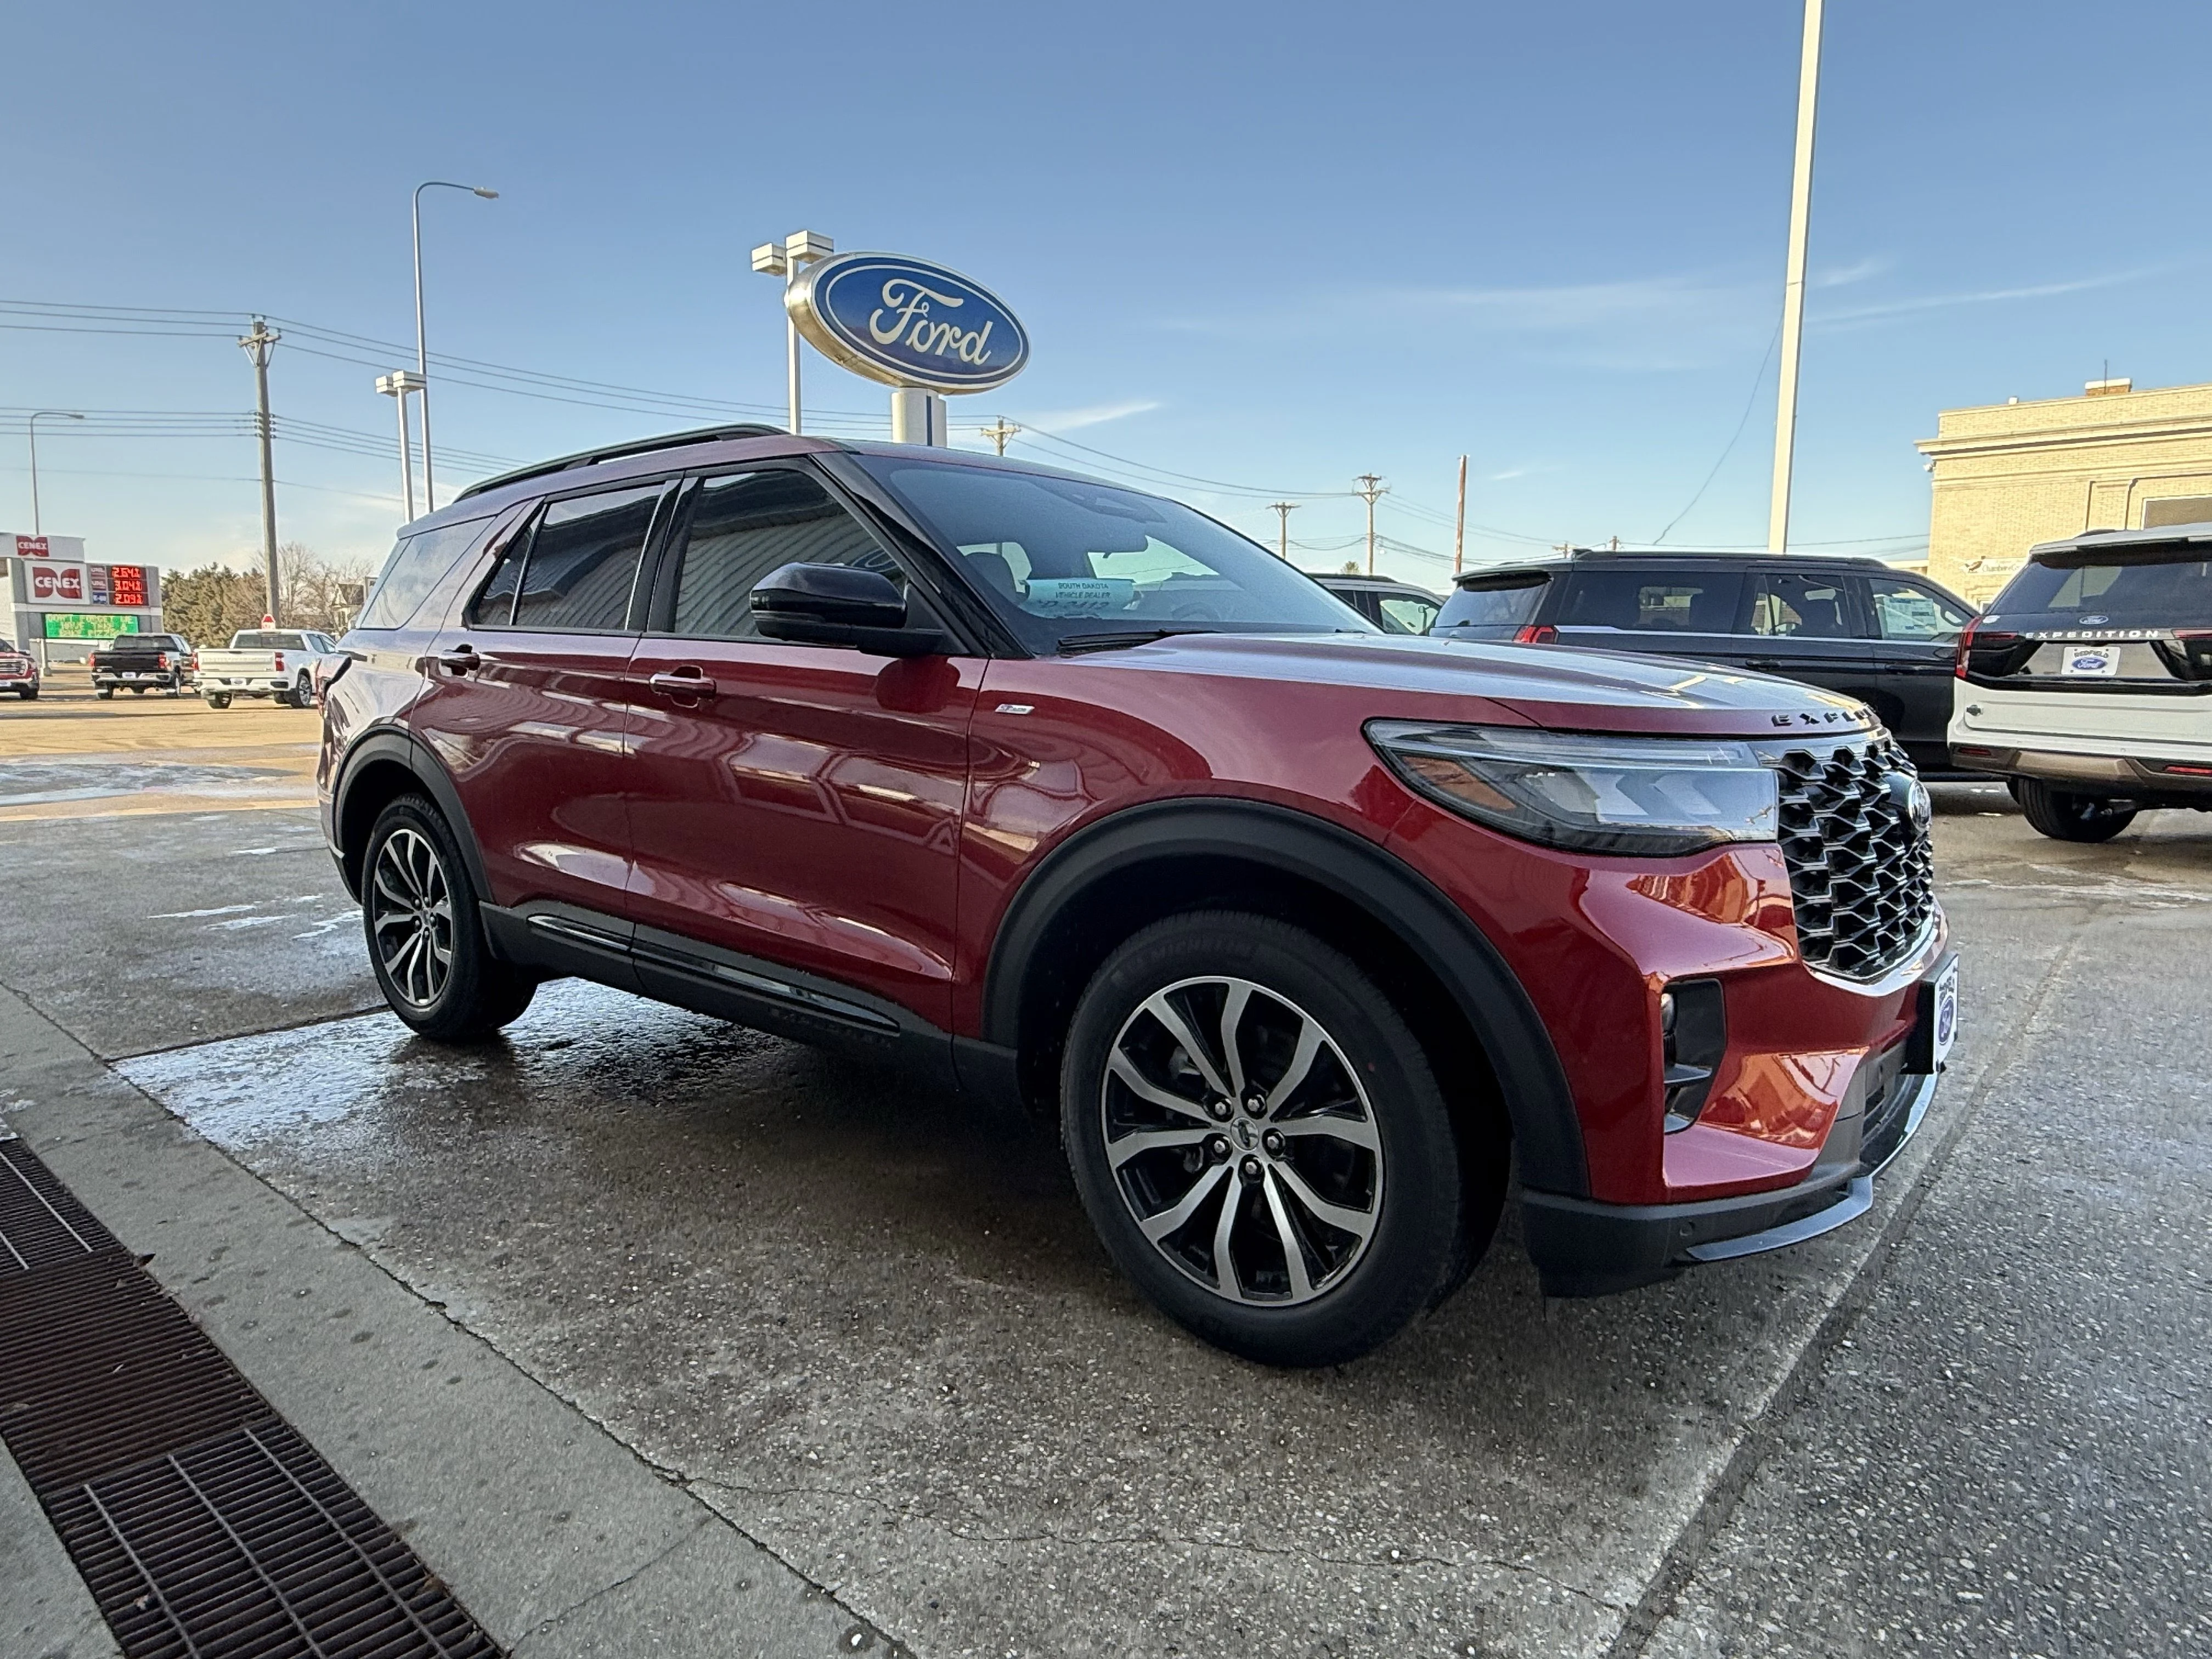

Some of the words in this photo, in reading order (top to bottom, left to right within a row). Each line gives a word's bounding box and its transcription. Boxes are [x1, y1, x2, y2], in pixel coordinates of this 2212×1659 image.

[869, 279, 993, 365] Ford
[18, 541, 47, 550] CENEX
[35, 577, 80, 589] CENEX
[2025, 630, 2159, 639] EXPEDITION
[2077, 659, 2102, 668] Ford
